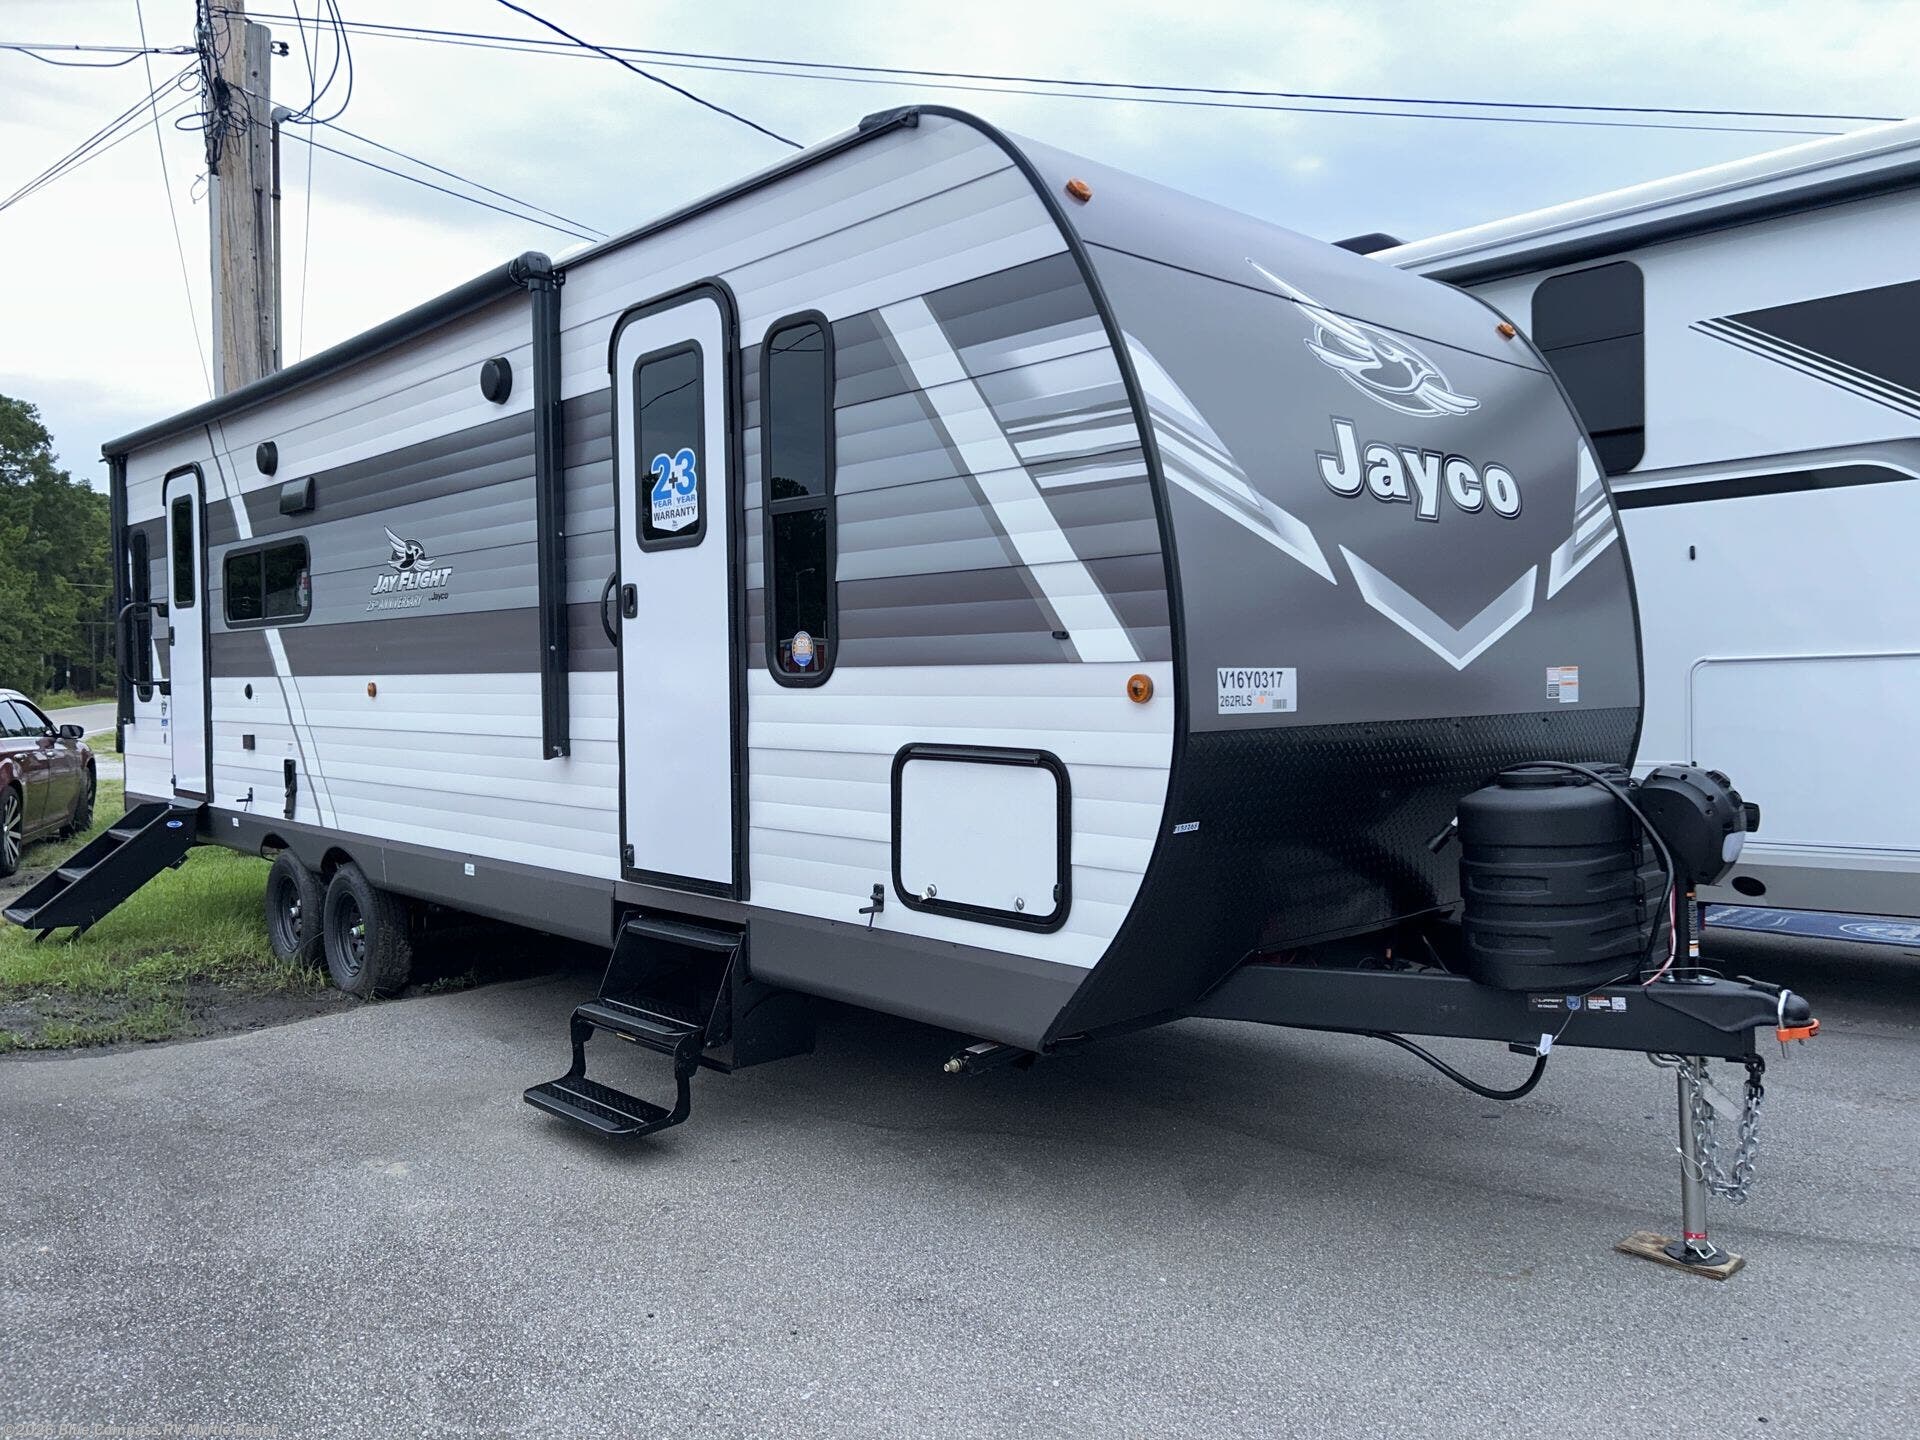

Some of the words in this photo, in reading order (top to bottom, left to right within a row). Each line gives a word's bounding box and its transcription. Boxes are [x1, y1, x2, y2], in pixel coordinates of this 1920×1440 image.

[1316, 416, 1522, 522] Jayco
[653, 499, 672, 508] YEAR
[676, 494, 696, 504] YEAR
[653, 505, 697, 521] WARRANTY
[371, 574, 399, 595] JAY
[397, 567, 453, 592] FLIGHT
[1218, 671, 1283, 689] V16Y0317
[1220, 695, 1253, 707] 262RLS
